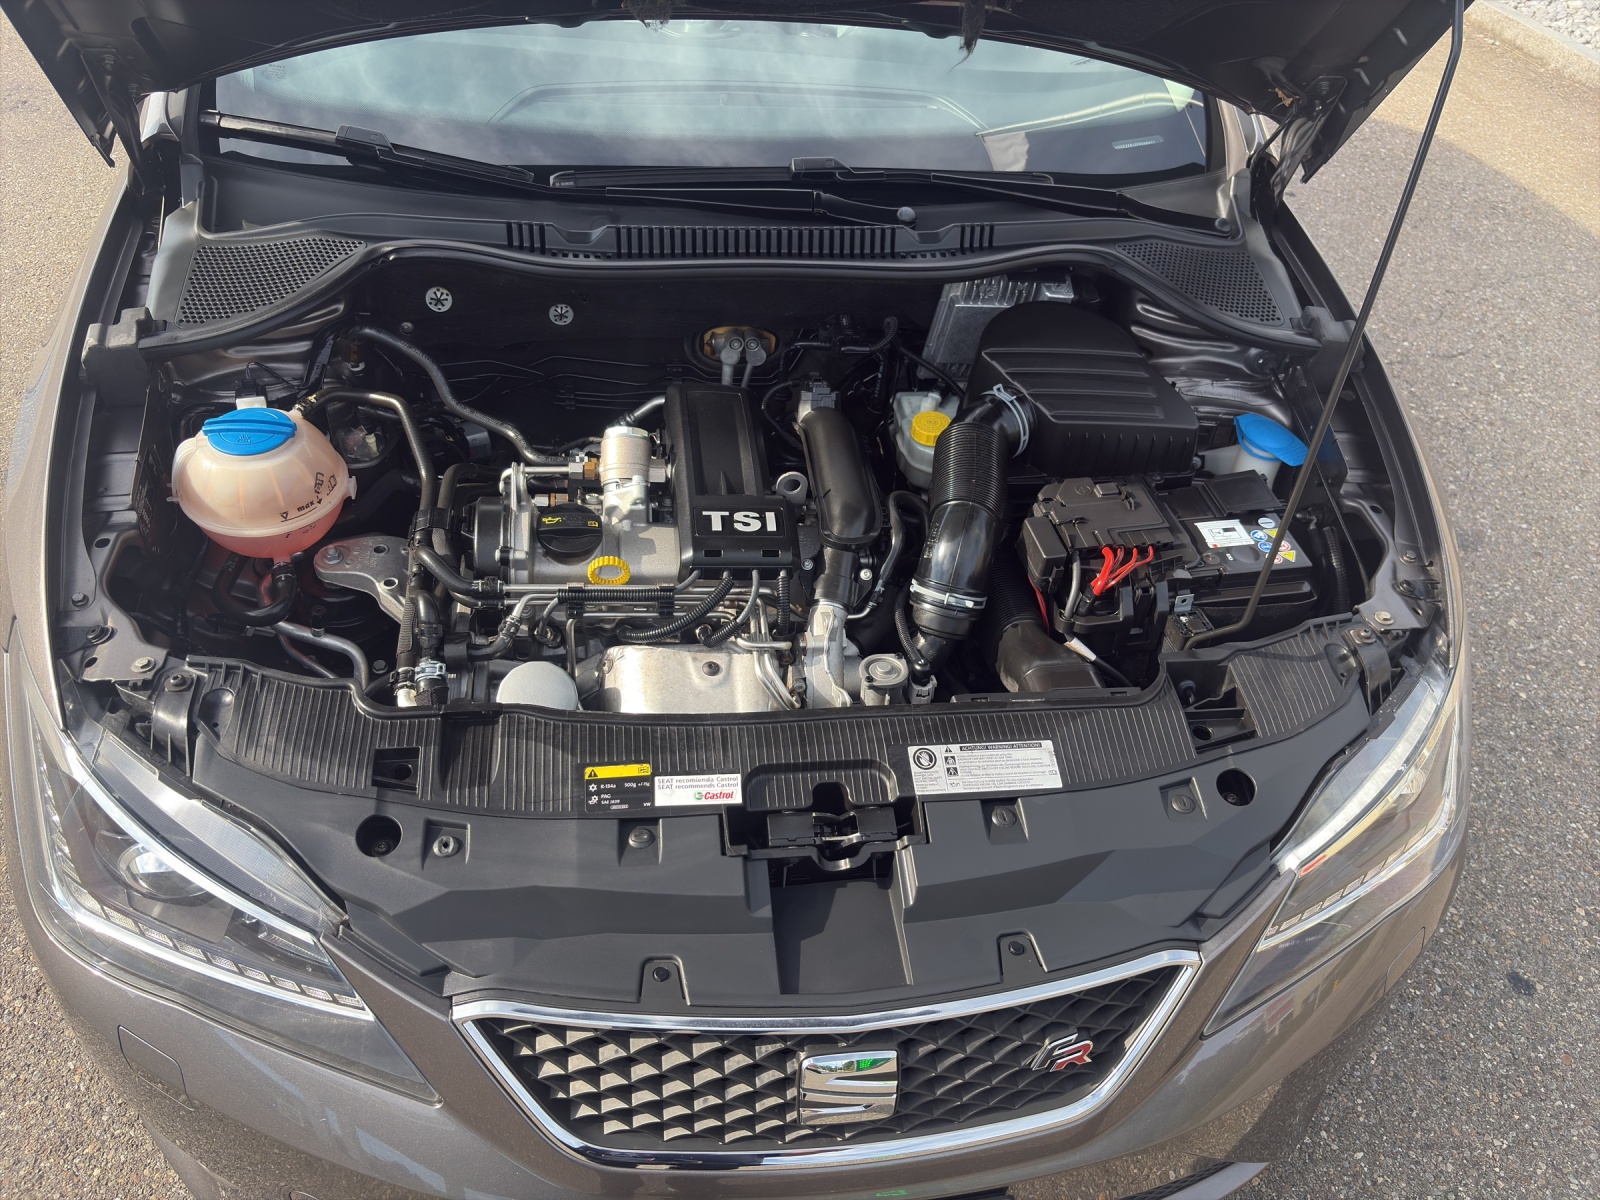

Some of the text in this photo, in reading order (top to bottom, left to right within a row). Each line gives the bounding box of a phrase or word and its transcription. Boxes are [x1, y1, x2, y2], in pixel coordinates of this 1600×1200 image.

[296, 500, 315, 512] max
[702, 511, 777, 532] TSI
[704, 791, 734, 800] Castrol
[1031, 1033, 1093, 1072] FR
